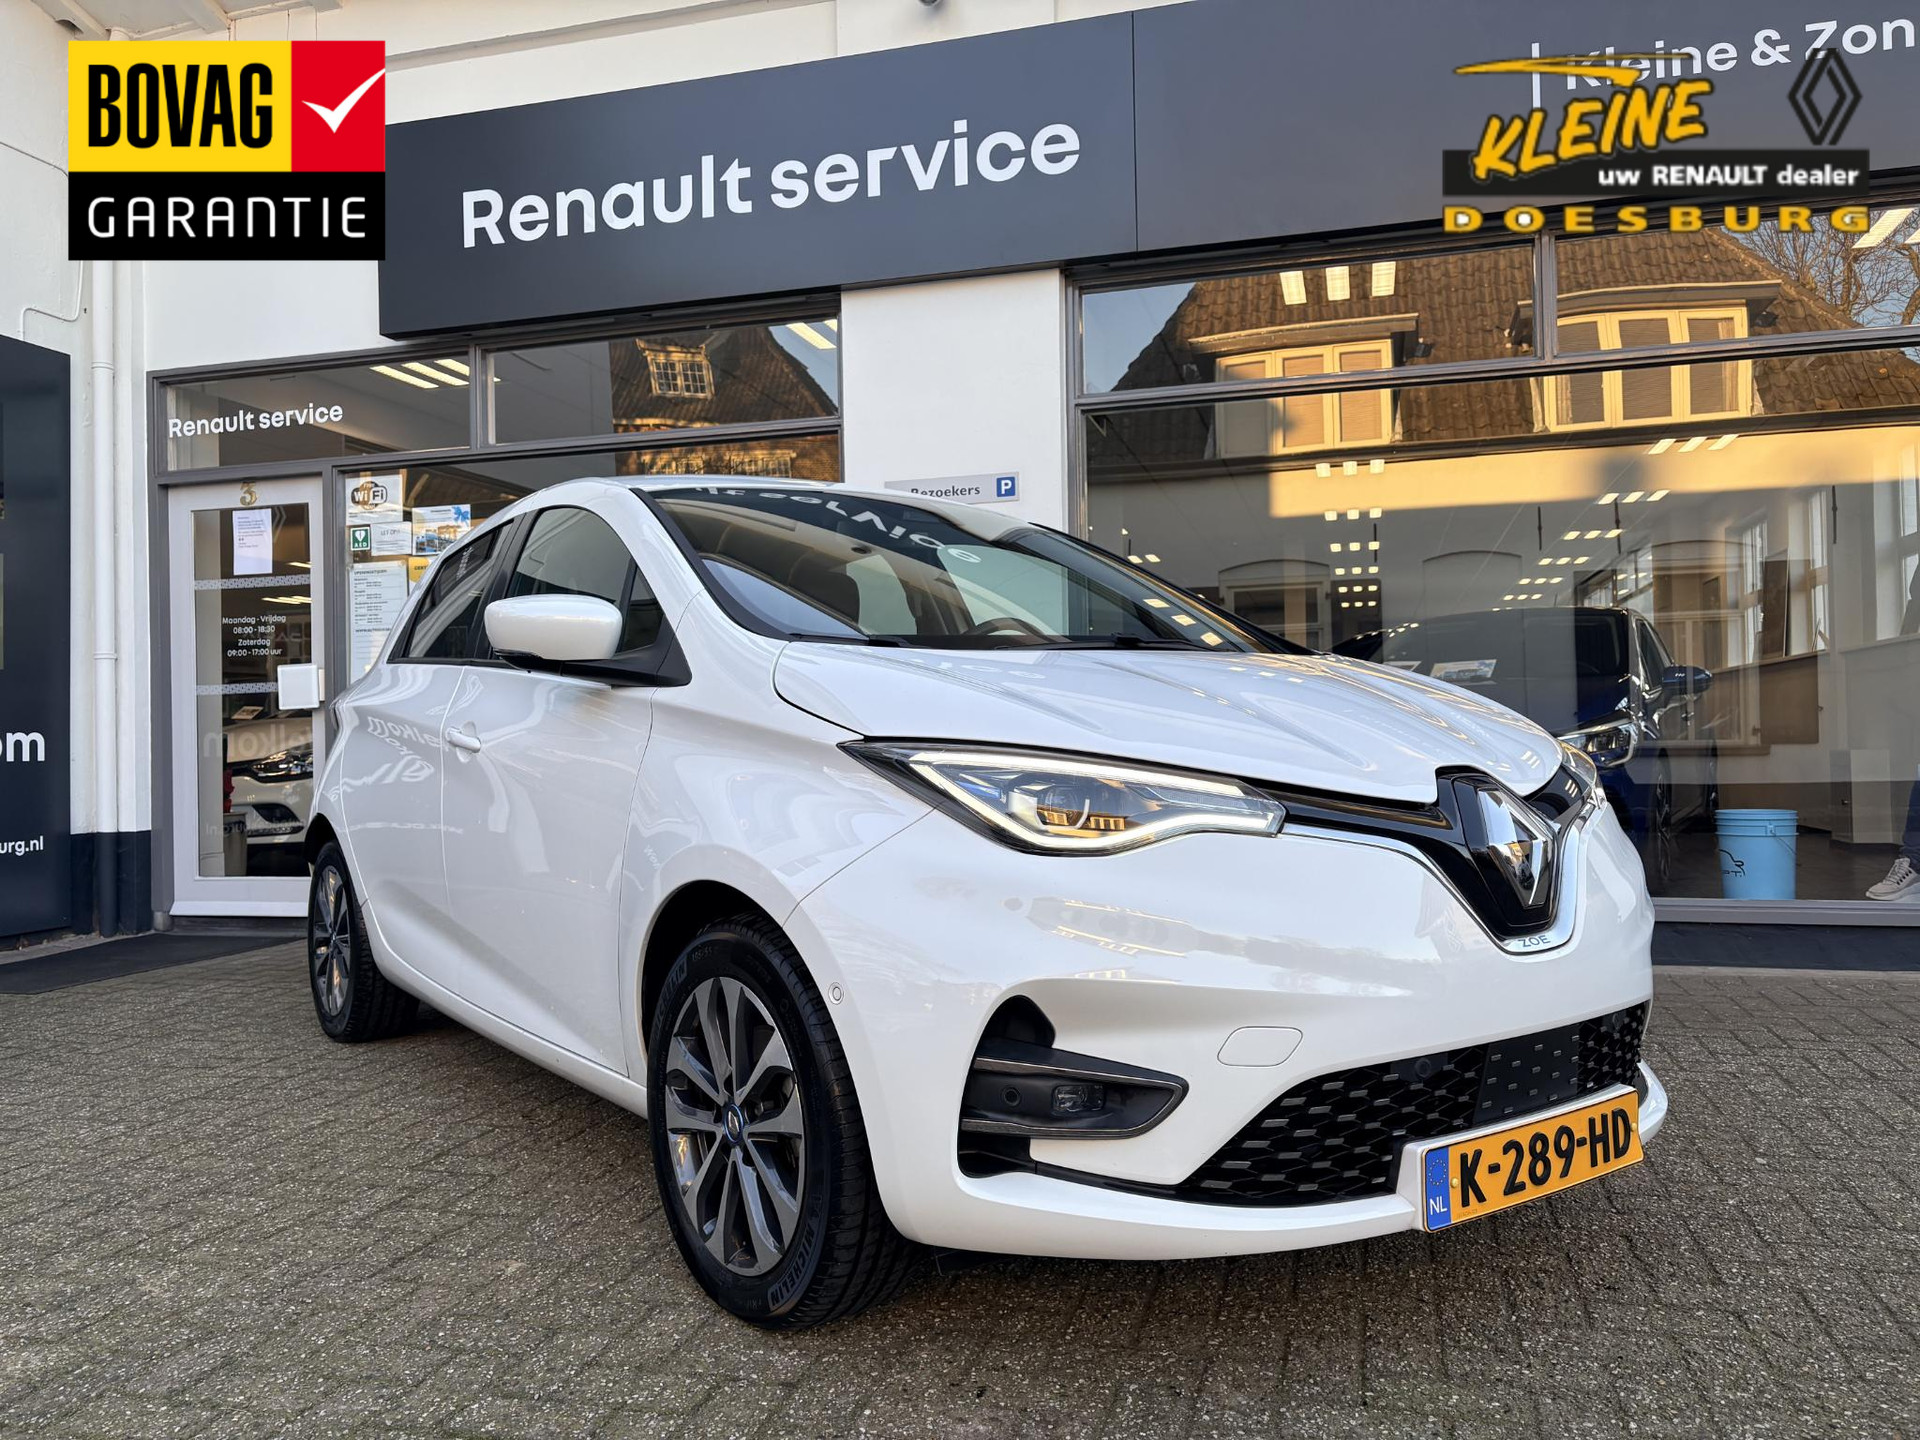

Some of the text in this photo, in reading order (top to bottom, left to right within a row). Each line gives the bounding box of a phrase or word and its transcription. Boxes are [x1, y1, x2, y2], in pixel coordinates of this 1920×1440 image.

[1750, 29, 1792, 66] &
[462, 118, 1081, 249] Renault service
[168, 402, 343, 438] Renault service
[239, 482, 258, 506] 3
[222, 616, 256, 625] Maandag
[260, 614, 287, 624] Vrijdag
[232, 626, 254, 634] 08:00
[257, 625, 276, 633] 18:30
[227, 649, 248, 657] 09:00
[251, 648, 270, 656] 17:00
[237, 638, 271, 647] Zaterdag
[0, 732, 46, 762] m
[1518, 934, 1551, 948] ZOE
[1459, 1106, 1632, 1208] K-289-HD
[1429, 1195, 1448, 1216] NL
[769, 1218, 817, 1307] MICHELIN
